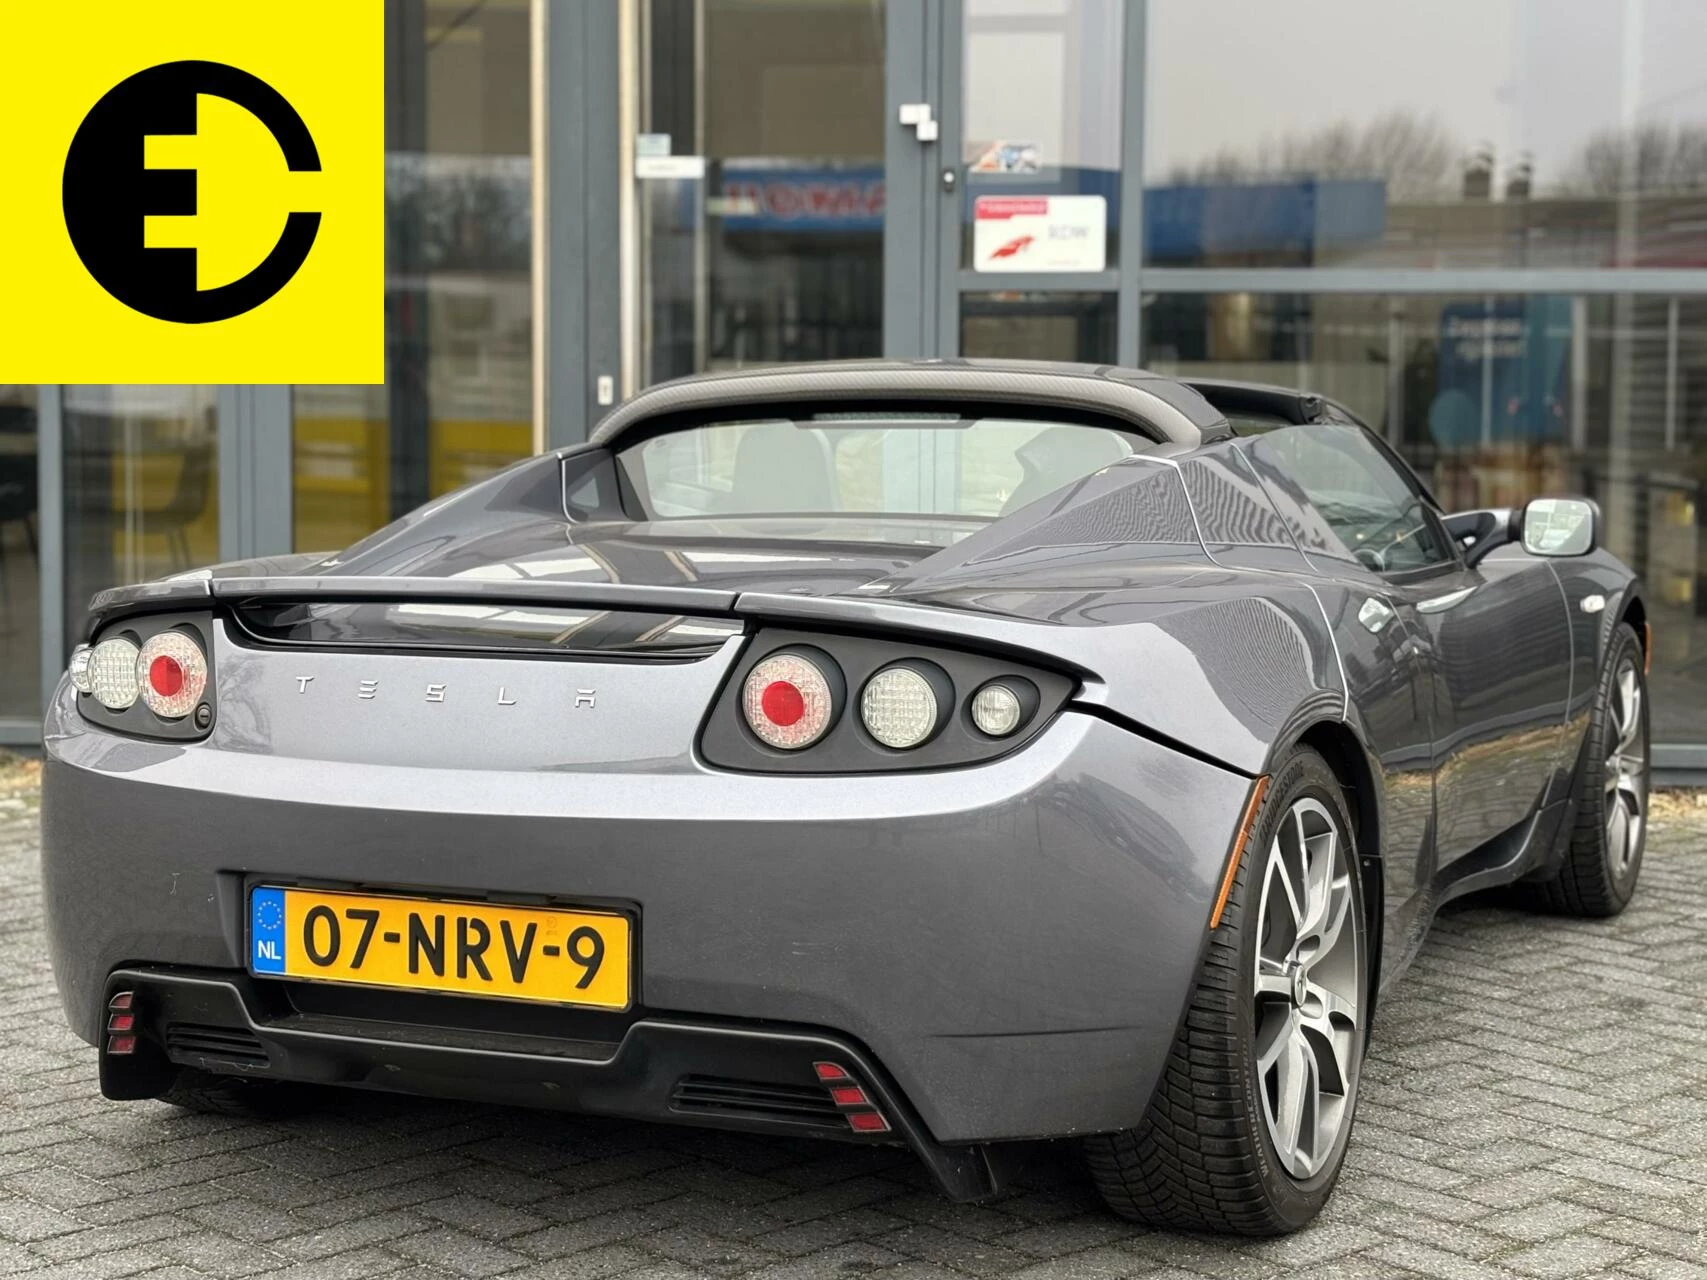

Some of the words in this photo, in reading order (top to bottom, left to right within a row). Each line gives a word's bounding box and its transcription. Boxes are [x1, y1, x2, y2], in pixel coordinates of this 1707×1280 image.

[295, 675, 597, 709] TESLA
[257, 939, 282, 960] NL
[302, 904, 606, 989] 07-NRV-9
